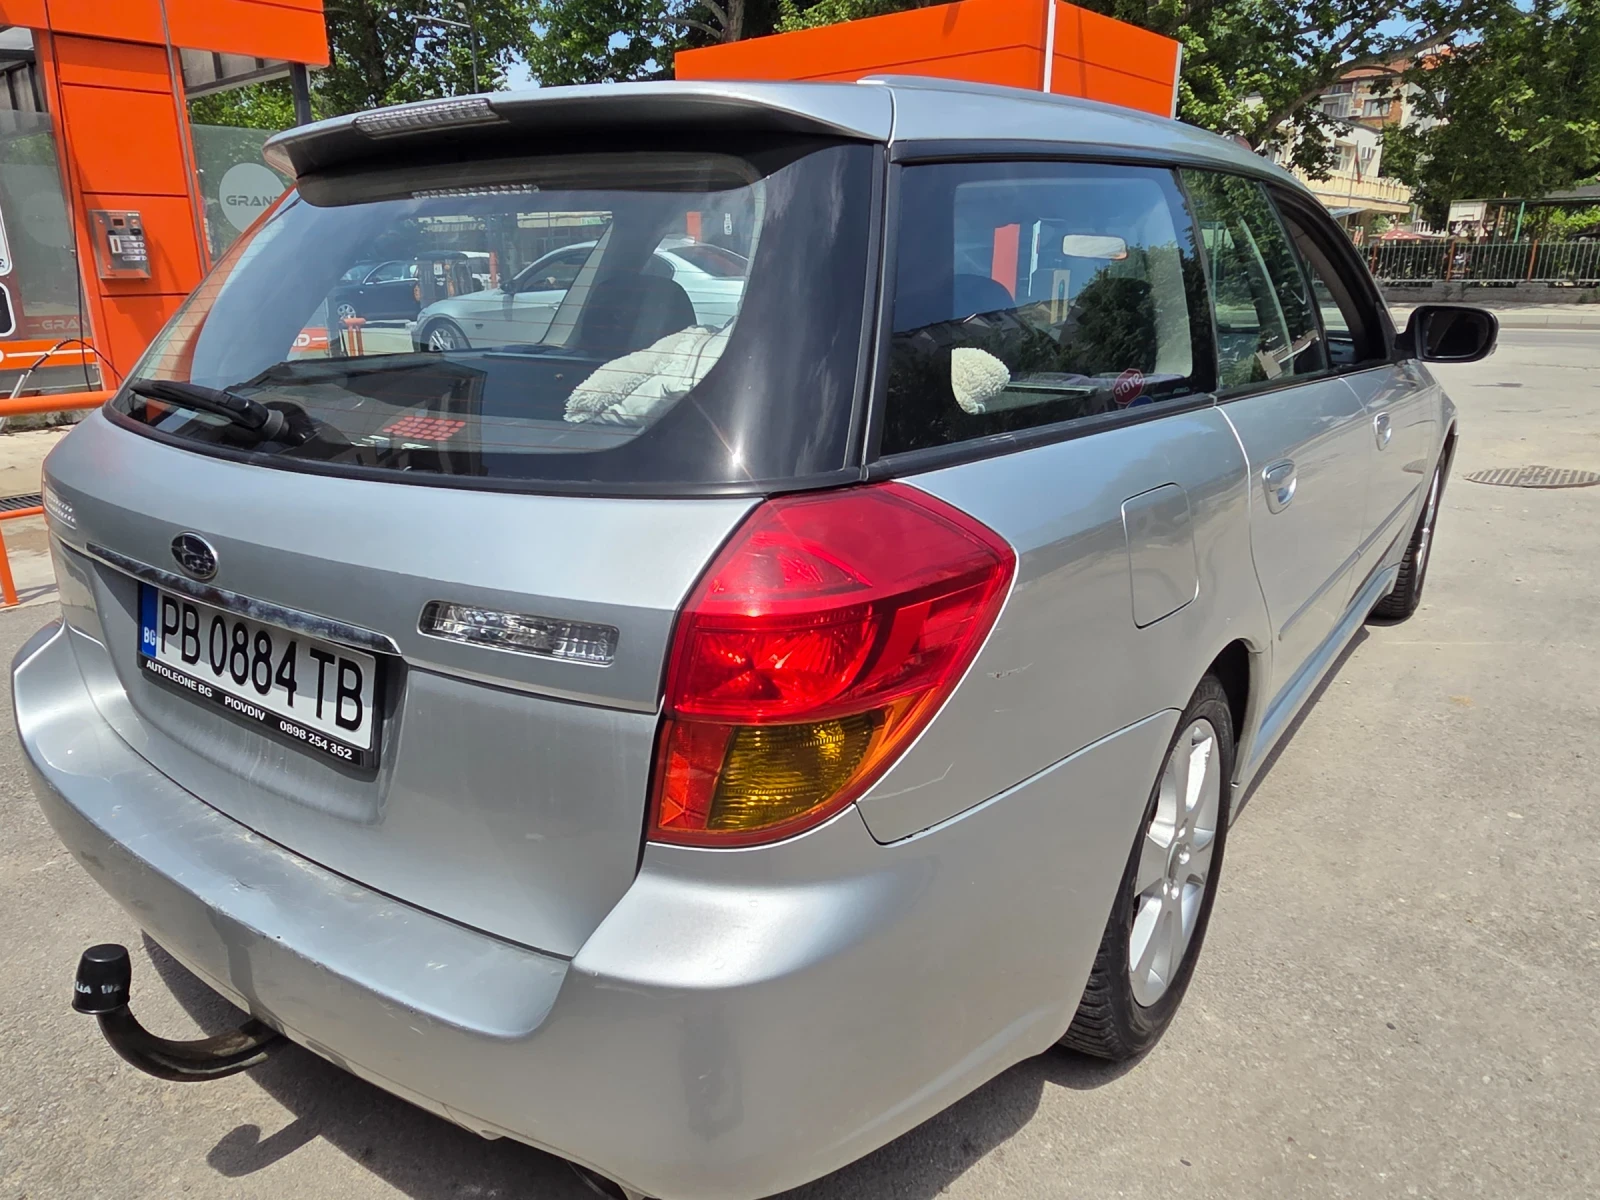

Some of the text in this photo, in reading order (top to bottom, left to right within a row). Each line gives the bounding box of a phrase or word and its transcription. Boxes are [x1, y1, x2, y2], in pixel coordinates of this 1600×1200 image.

[143, 626, 156, 646] BG
[209, 615, 298, 709] 0884
[309, 647, 363, 732] TB
[146, 660, 197, 691] AUTOLEONE
[198, 683, 213, 698] BG
[279, 720, 307, 740] 0898
[308, 733, 328, 750] 254
[329, 742, 353, 760] 352
